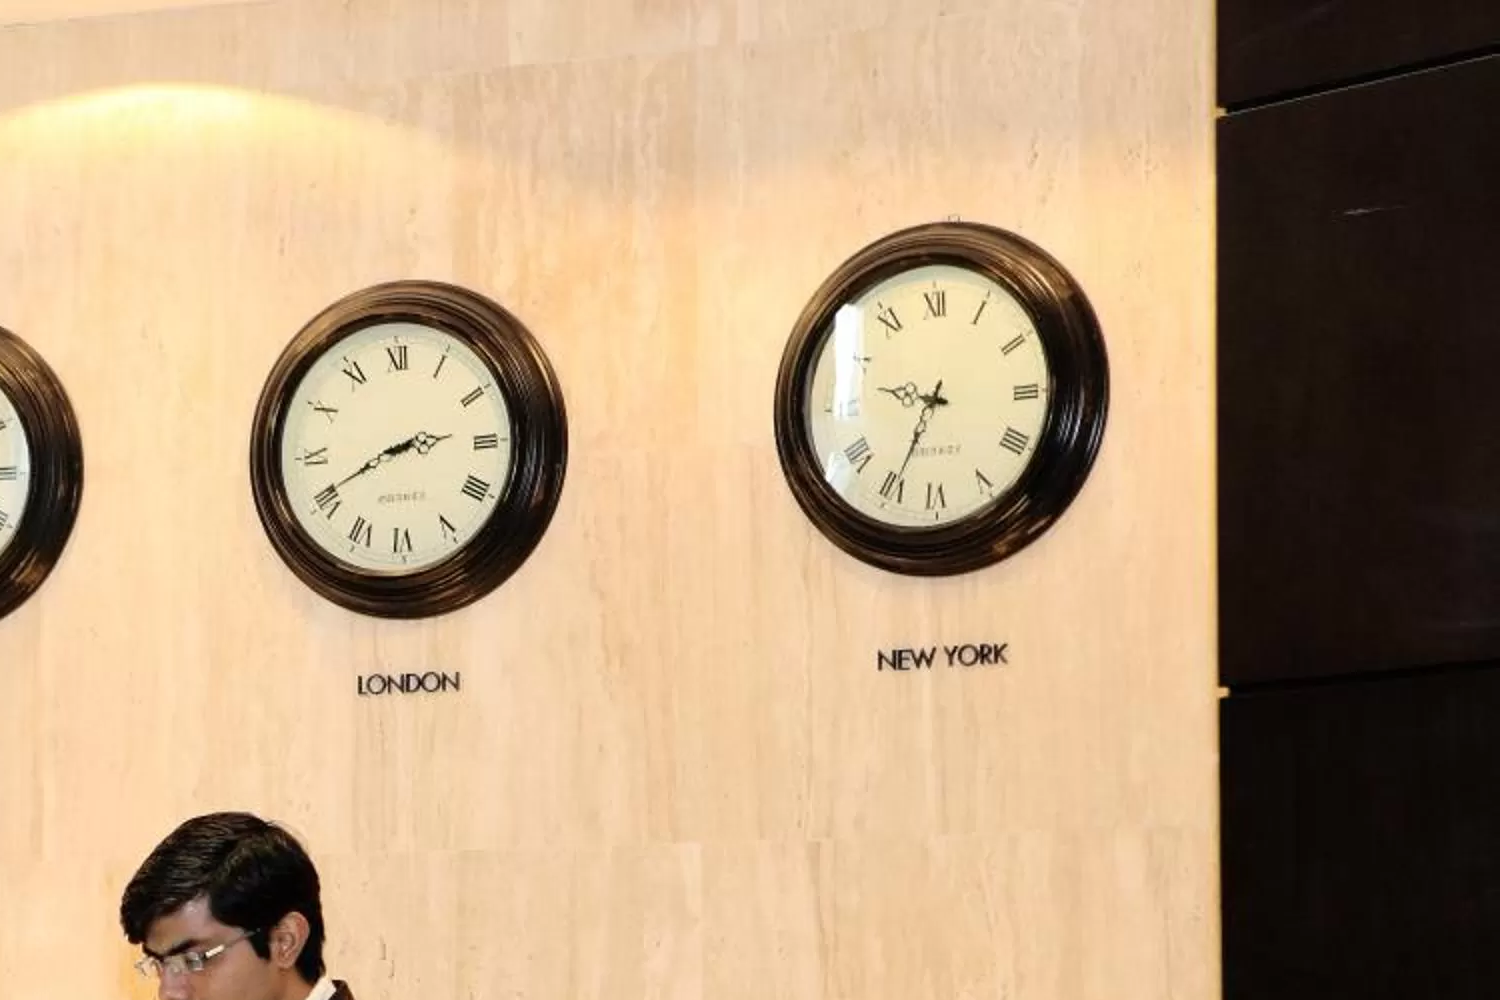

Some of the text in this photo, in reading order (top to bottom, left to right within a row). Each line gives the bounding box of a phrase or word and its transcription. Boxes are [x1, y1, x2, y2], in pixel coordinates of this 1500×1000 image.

[878, 643, 1008, 671] NEW YORK
[358, 671, 461, 695] LONDON
